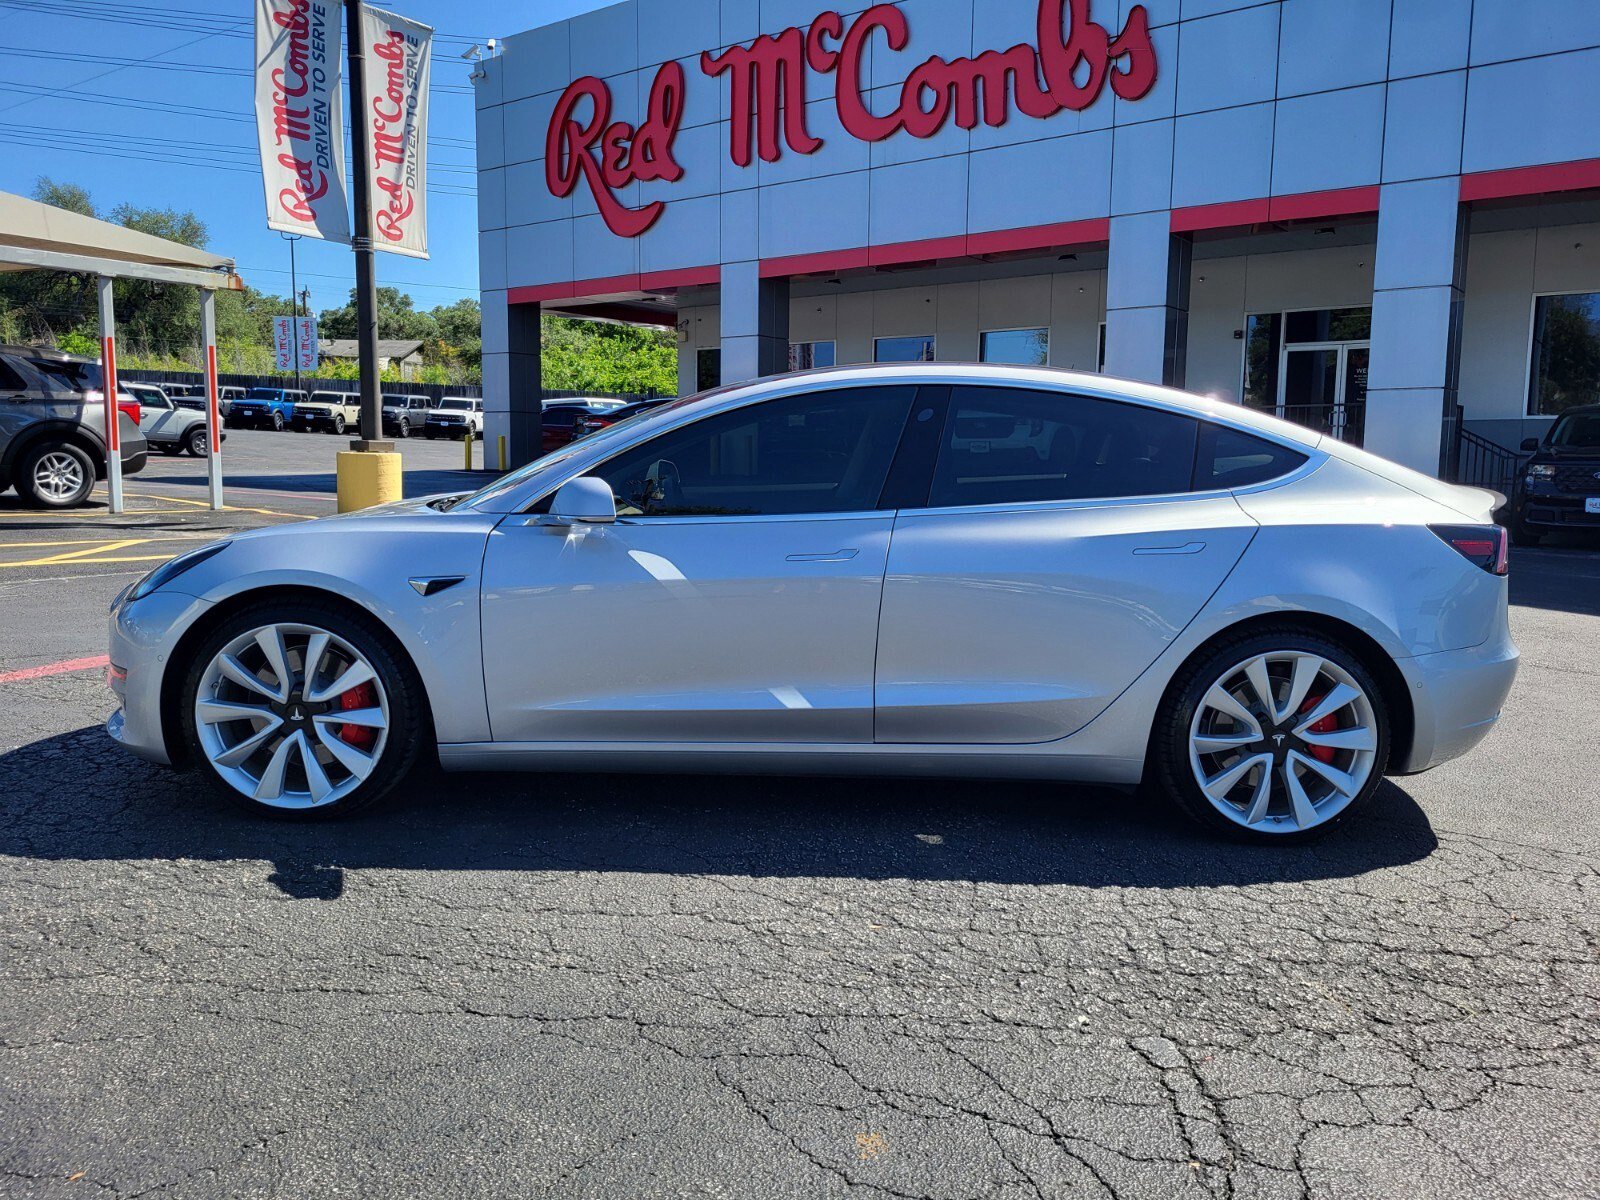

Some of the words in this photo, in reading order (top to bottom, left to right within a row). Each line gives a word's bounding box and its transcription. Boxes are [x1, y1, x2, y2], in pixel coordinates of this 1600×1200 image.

[312, 3, 326, 64] SERVE
[406, 35, 419, 90] SERVE
[271, 0, 311, 146] McCombs
[312, 69, 326, 93] TO
[373, 30, 405, 170] McCombs
[406, 94, 418, 118] TO
[315, 99, 330, 170] DRIVEN
[545, 60, 685, 238] Red
[700, 0, 1159, 168] McCombs
[277, 153, 329, 222] Red
[406, 124, 417, 190] DRIVEN
[376, 176, 414, 242] Red
